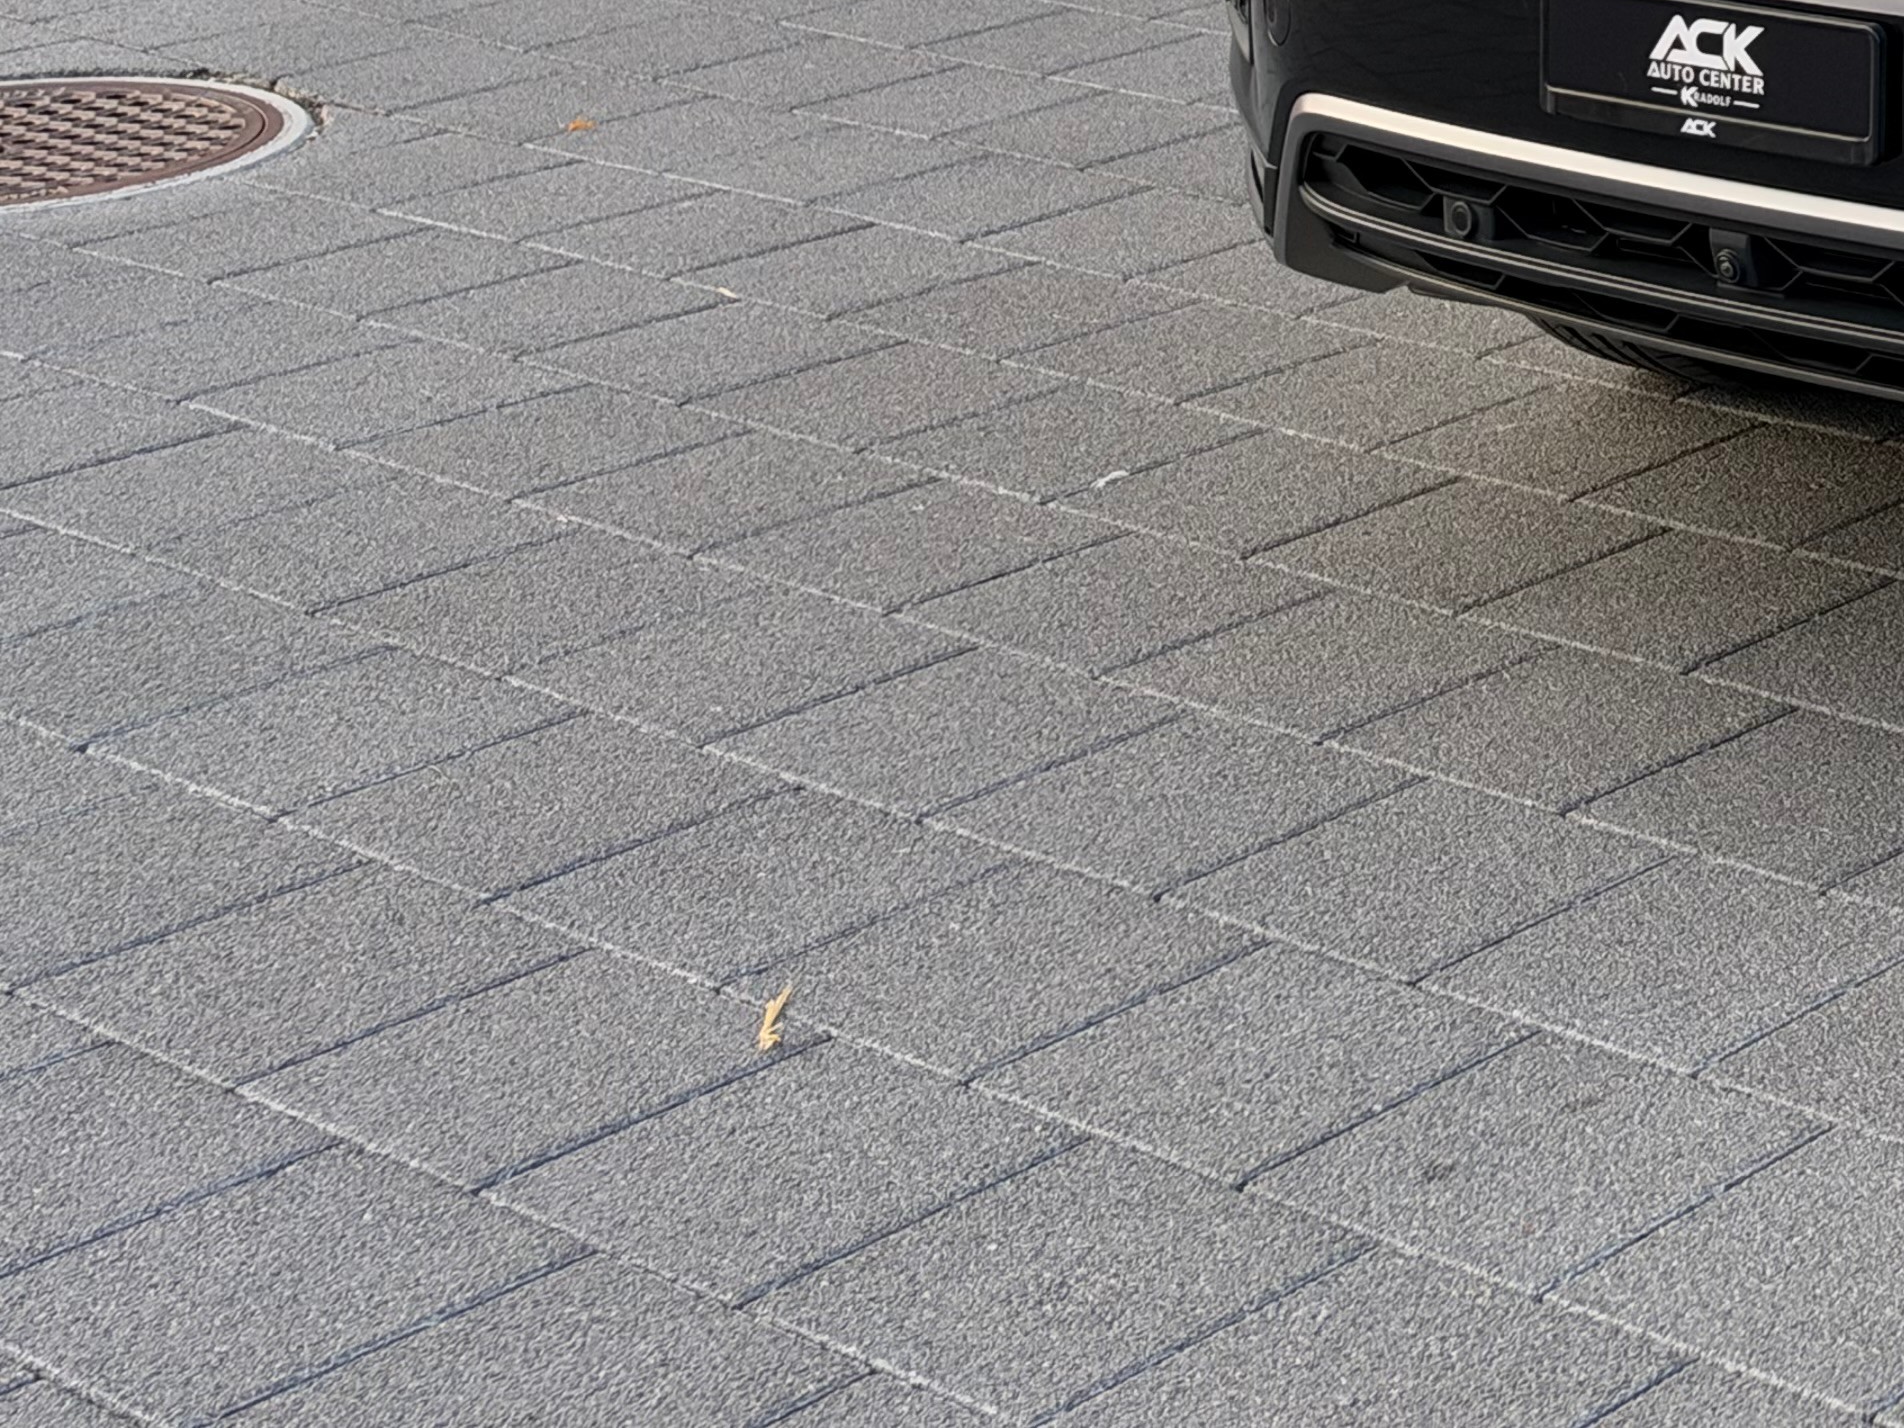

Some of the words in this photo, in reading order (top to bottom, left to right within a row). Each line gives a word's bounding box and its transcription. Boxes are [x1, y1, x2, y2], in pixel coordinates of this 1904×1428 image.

[1648, 13, 1764, 77] ACK
[1647, 60, 1695, 84] AUTO
[1699, 67, 1765, 96] CENTER
[1680, 118, 1716, 139] ACK
